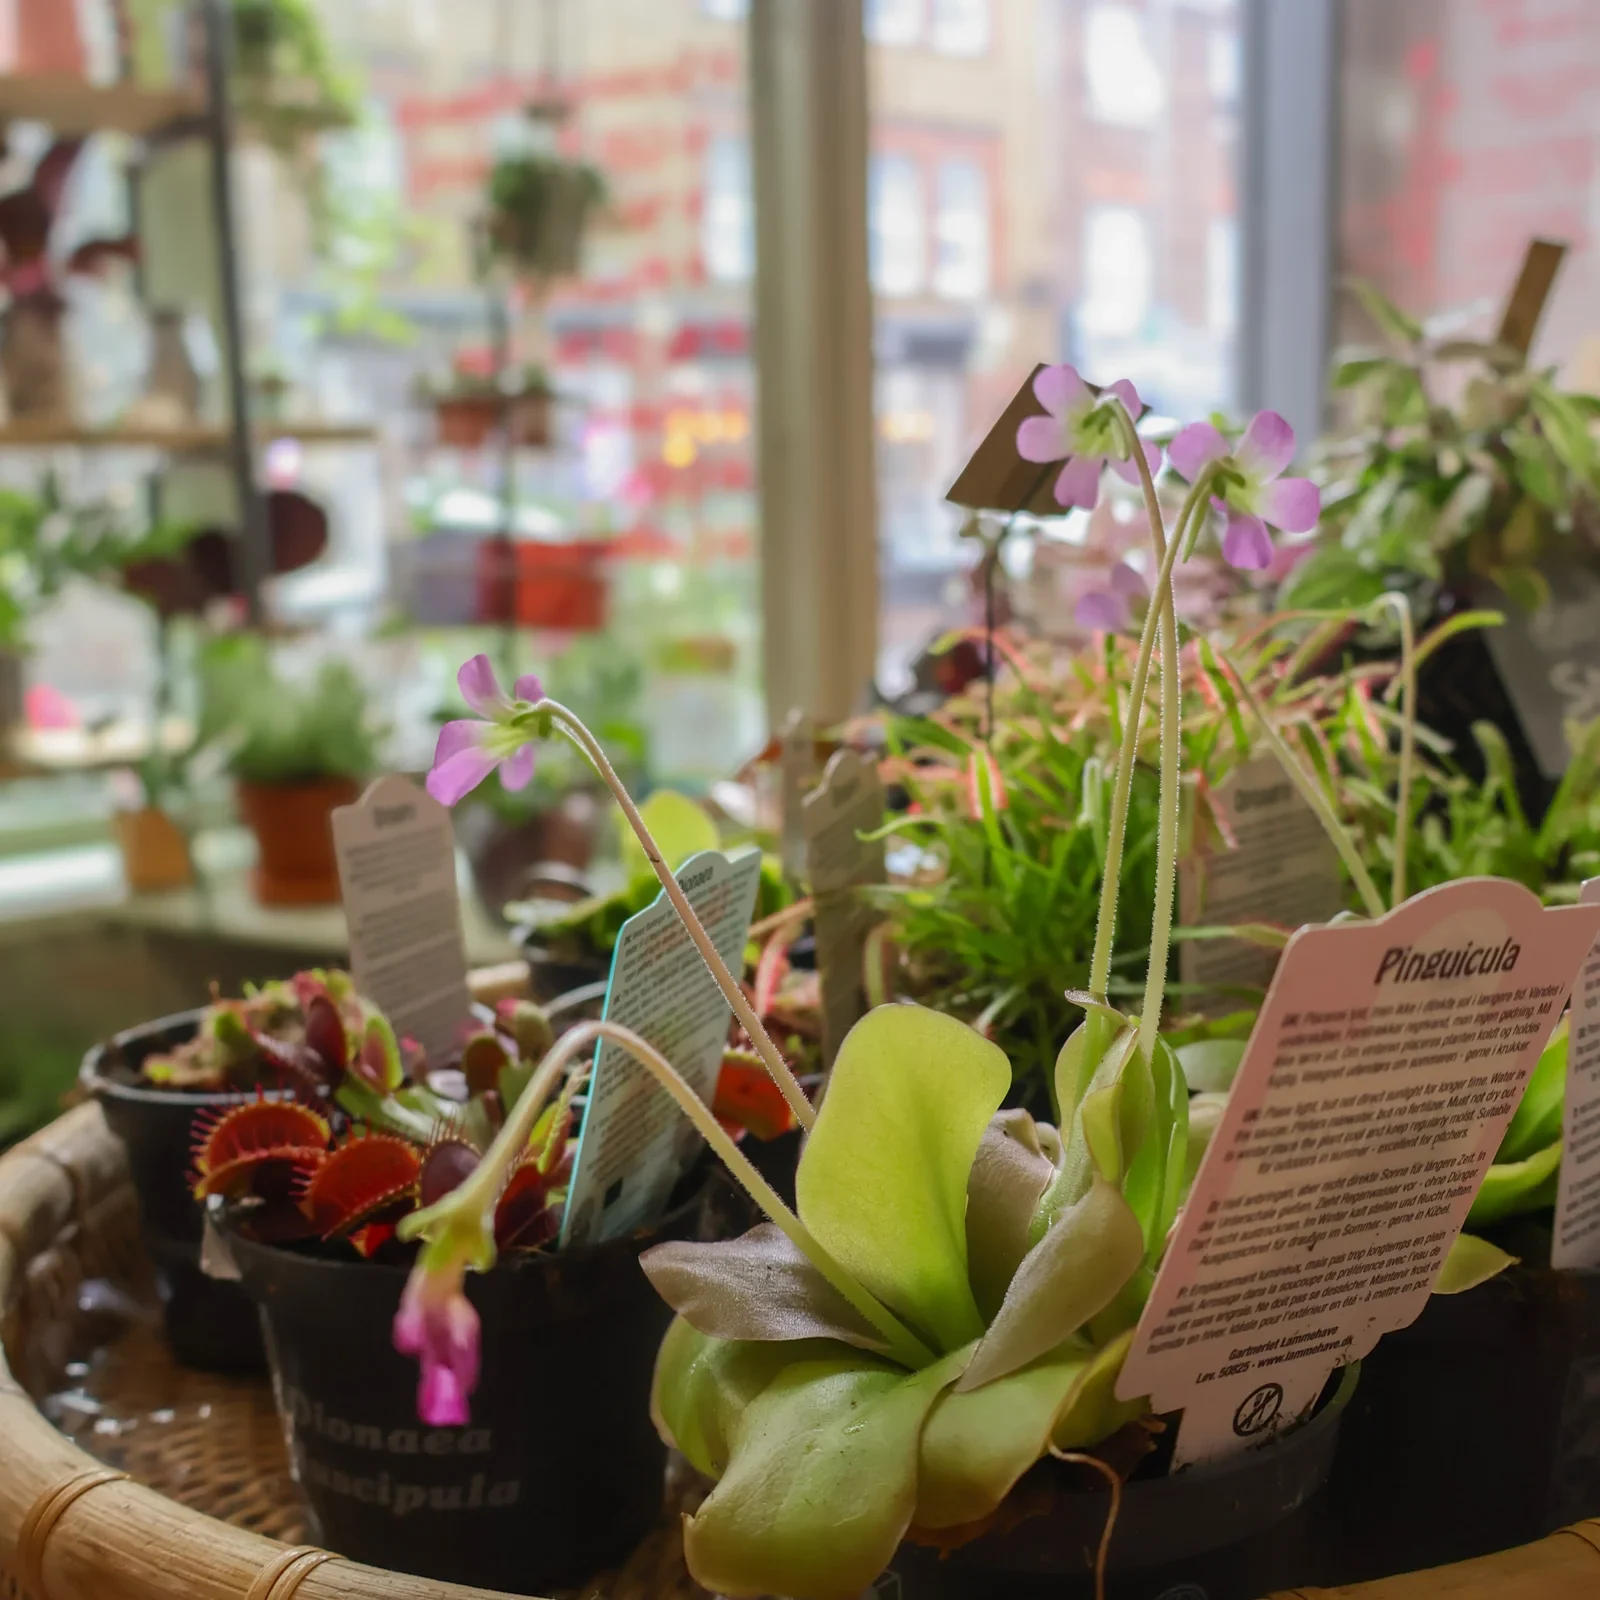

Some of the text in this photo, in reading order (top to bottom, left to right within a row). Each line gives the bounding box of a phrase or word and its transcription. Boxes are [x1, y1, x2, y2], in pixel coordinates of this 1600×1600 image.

[1373, 936, 1521, 985] Pinguicula
[1526, 983, 1561, 999] Vandes
[1536, 1001, 1553, 1015] Må
[1440, 1028, 1478, 1047] planten
[1497, 1026, 1513, 1040] og
[1511, 1020, 1543, 1035] holdes
[1463, 1047, 1492, 1062] gerne
[1495, 1038, 1533, 1054] krukker.
[1422, 1080, 1439, 1094] for
[1436, 1076, 1469, 1095] longer
[1488, 1068, 1517, 1084] Water
[1514, 1067, 1528, 1080] in
[1392, 1105, 1407, 1116] no
[1446, 1092, 1471, 1107] Must
[1469, 1090, 1487, 1103] not
[1483, 1087, 1502, 1104] dry
[1383, 1119, 1411, 1137] keep
[1408, 1112, 1451, 1133] regularly
[1475, 1102, 1513, 1119] Suitable
[1417, 1132, 1434, 1146] for
[1430, 1126, 1470, 1146] pitchers.
[1346, 1169, 1380, 1186] direkte
[1378, 1164, 1410, 1180] Sonne
[1475, 1149, 1488, 1162] In
[1339, 1181, 1402, 1206] Regenwasser
[1401, 1181, 1417, 1192] vor
[1423, 1172, 1449, 1187] ohne
[1316, 1208, 1349, 1225] Winter
[1366, 1198, 1399, 1215] stellen
[1397, 1194, 1418, 1209] und
[1327, 1225, 1343, 1239] im
[1341, 1217, 1382, 1236] Sommer
[1414, 1207, 1426, 1220] in
[1326, 1253, 1347, 1267] pas
[1345, 1246, 1367, 1263] trop
[1365, 1236, 1414, 1258] longtemps
[1411, 1235, 1425, 1246] en
[1423, 1228, 1448, 1246] plein
[1254, 1299, 1271, 1313] Ne
[1269, 1294, 1291, 1309] doit
[1288, 1293, 1308, 1307] pas
[1307, 1290, 1321, 1300] se
[1368, 1266, 1410, 1286] Maintenir
[1409, 1261, 1431, 1276] froid
[1429, 1259, 1442, 1272] et
[1276, 1274, 1323, 1294] soucoupe
[1323, 1268, 1338, 1281] de
[1335, 1257, 1387, 1281] préférence
[1384, 1255, 1408, 1267] avec
[1427, 1244, 1442, 1258] de
[1257, 1314, 1281, 1330] pour
[1327, 1300, 1341, 1310] en
[1341, 1293, 1359, 1307] été
[1371, 1283, 1402, 1300] mettre
[1400, 1282, 1413, 1293] en
[1410, 1275, 1432, 1292] pot.
[1227, 1322, 1341, 1360] Gartneriet Lammehave
[1256, 1333, 1355, 1368] www.lammehave.dk
